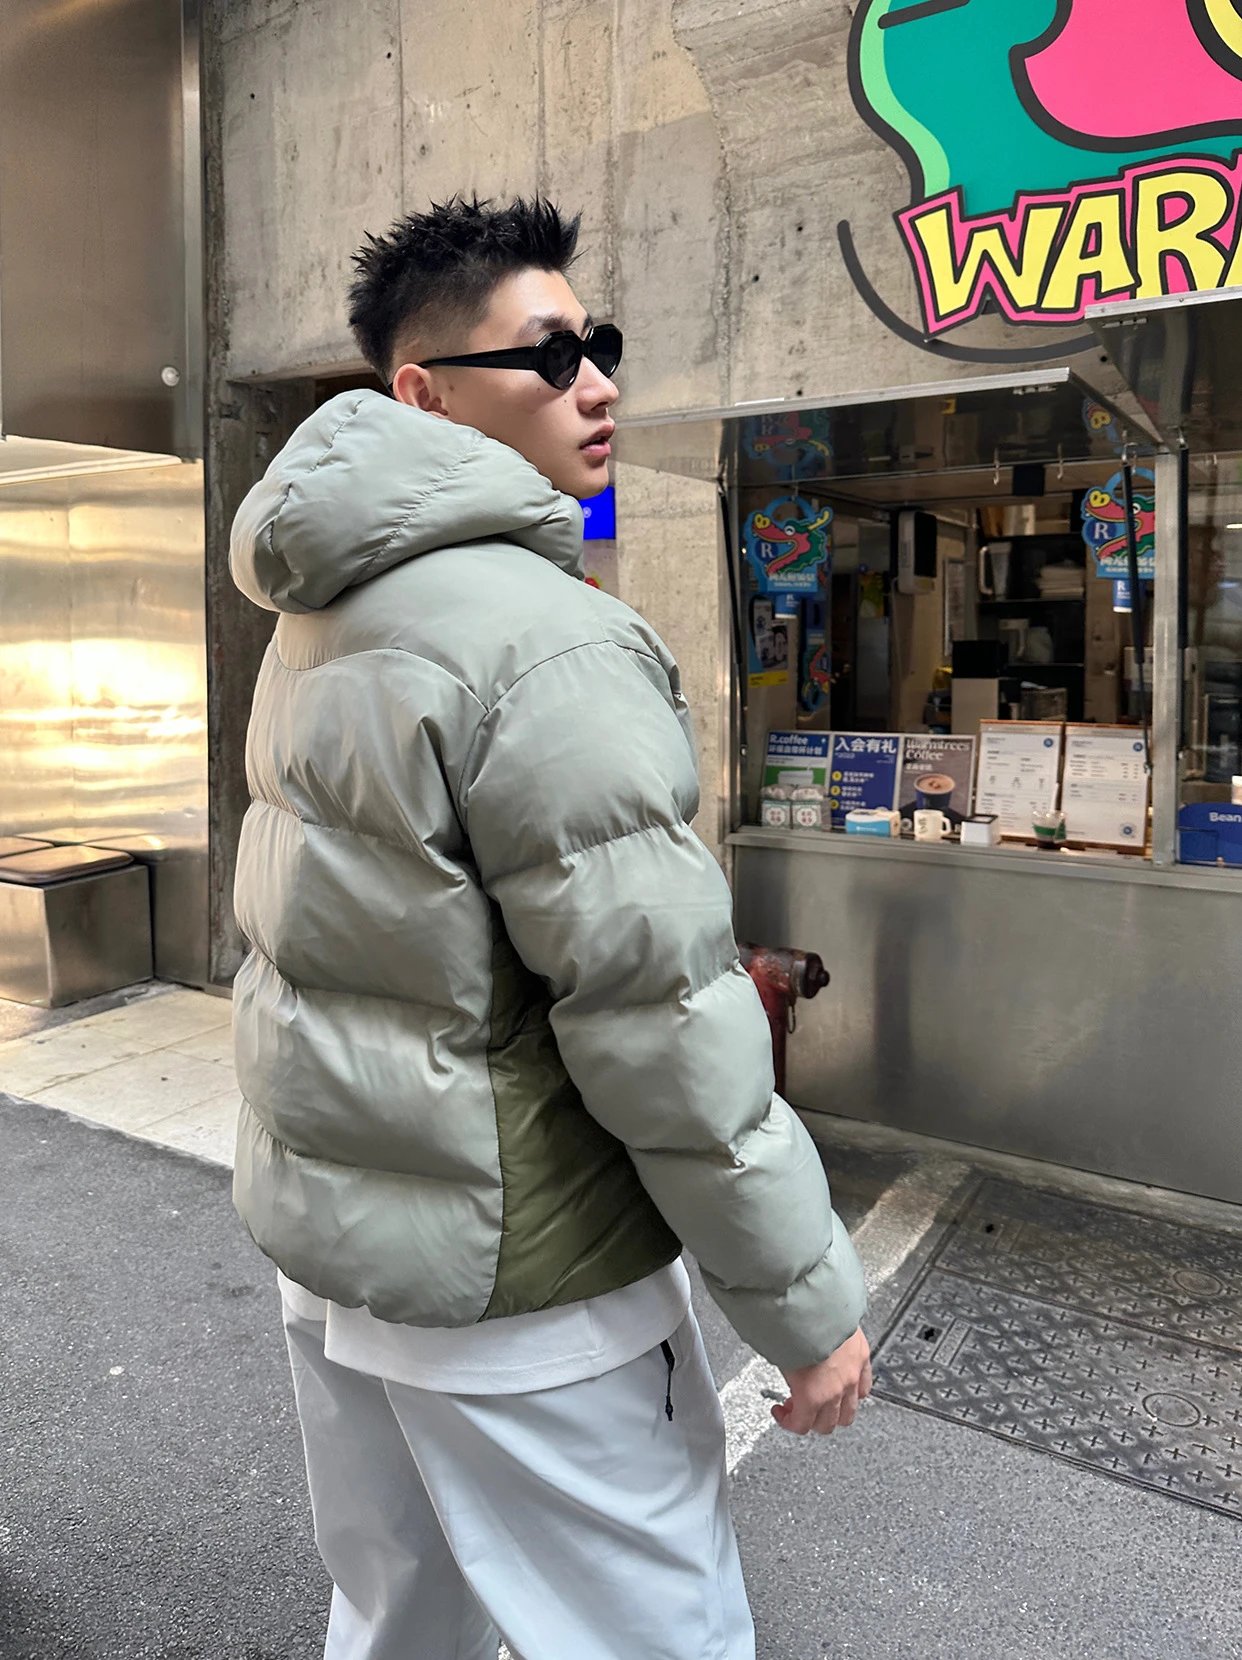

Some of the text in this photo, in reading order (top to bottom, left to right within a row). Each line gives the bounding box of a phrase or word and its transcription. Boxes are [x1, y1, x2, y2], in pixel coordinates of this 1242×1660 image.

[1094, 522, 1111, 540] R
[760, 542, 776, 559] R
[835, 737, 897, 753] 入会有礼
[905, 750, 944, 761] Coffee
